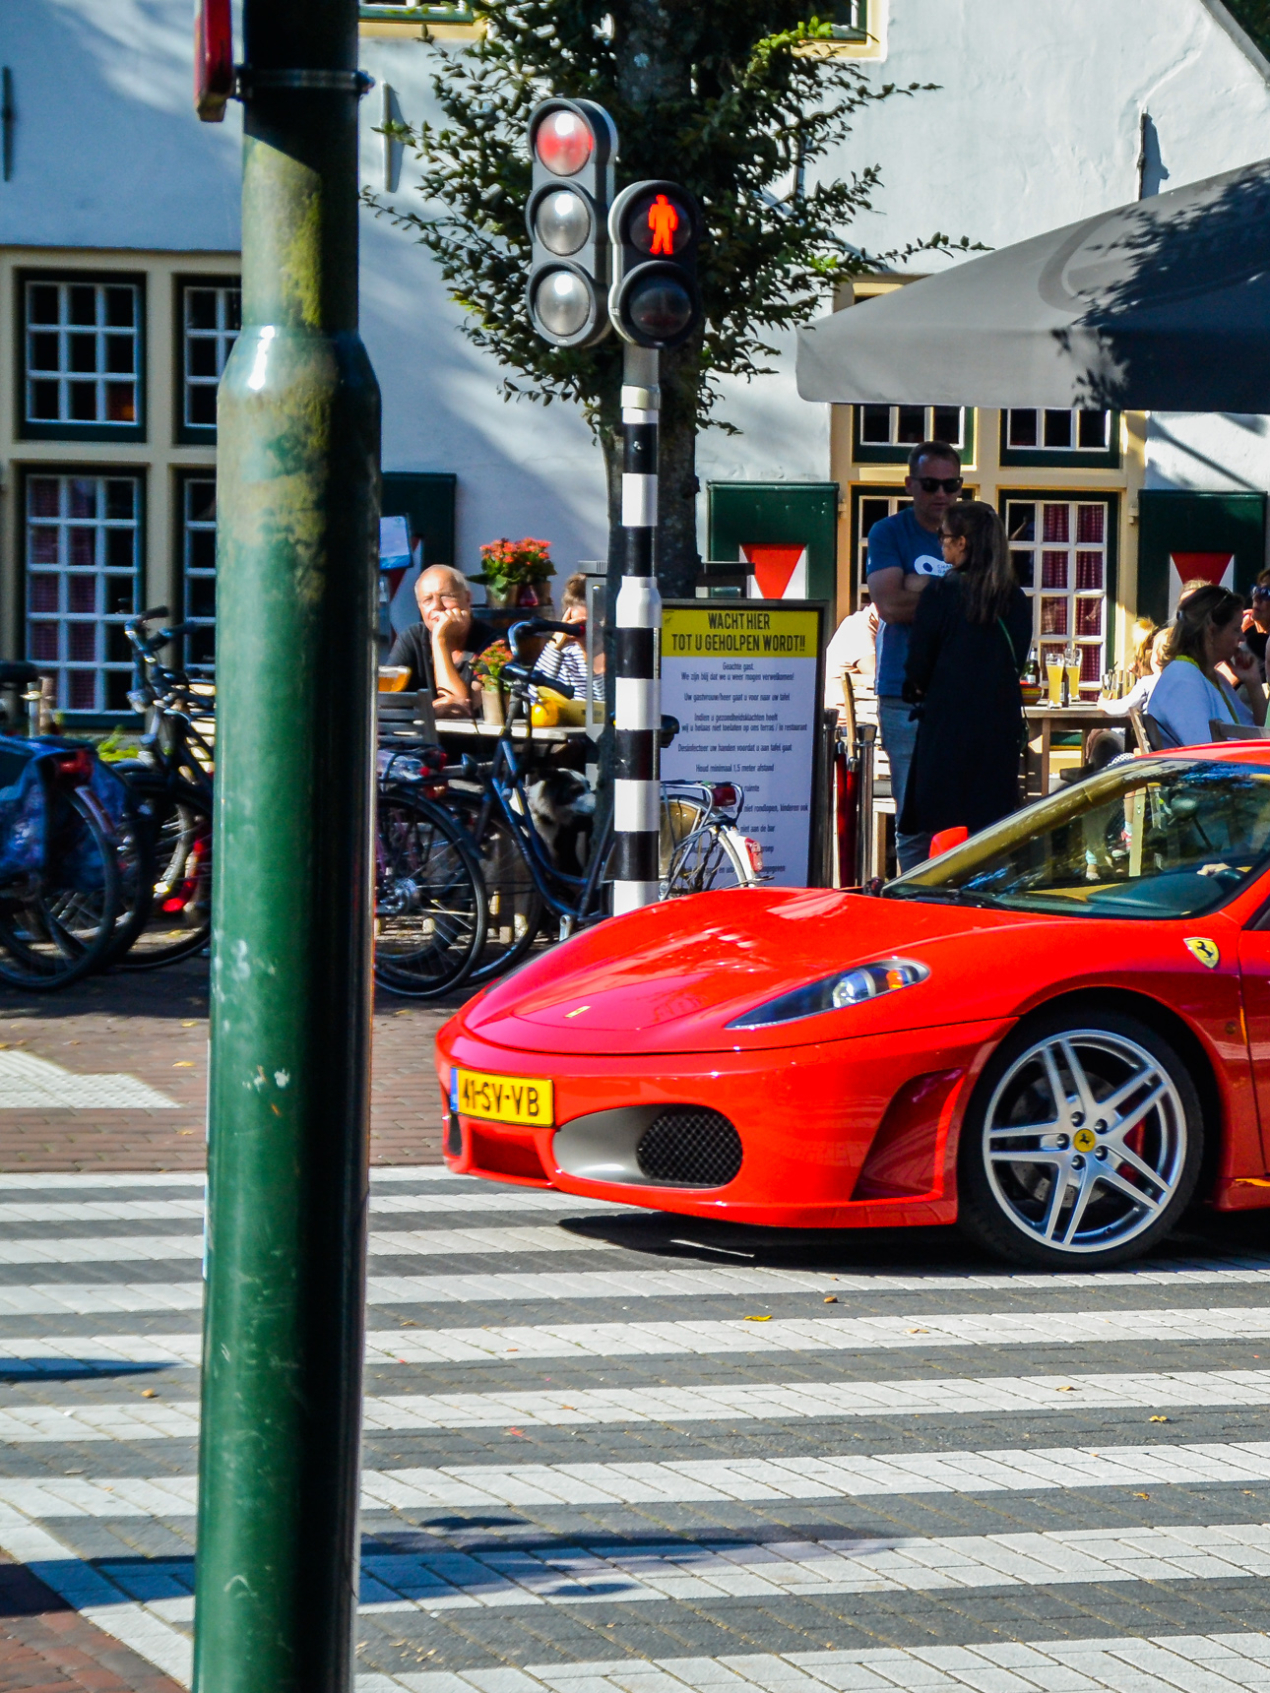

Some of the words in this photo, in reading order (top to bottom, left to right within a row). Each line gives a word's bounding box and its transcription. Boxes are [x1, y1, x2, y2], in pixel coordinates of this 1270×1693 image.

[708, 613, 745, 630] WACHT
[746, 613, 770, 630] HIER
[672, 634, 692, 650] TOT
[695, 634, 702, 650] U
[705, 634, 760, 651] GEHOLPEN
[763, 635, 805, 651] WORDT!!
[681, 672, 689, 680] We
[745, 674, 761, 682] mogen
